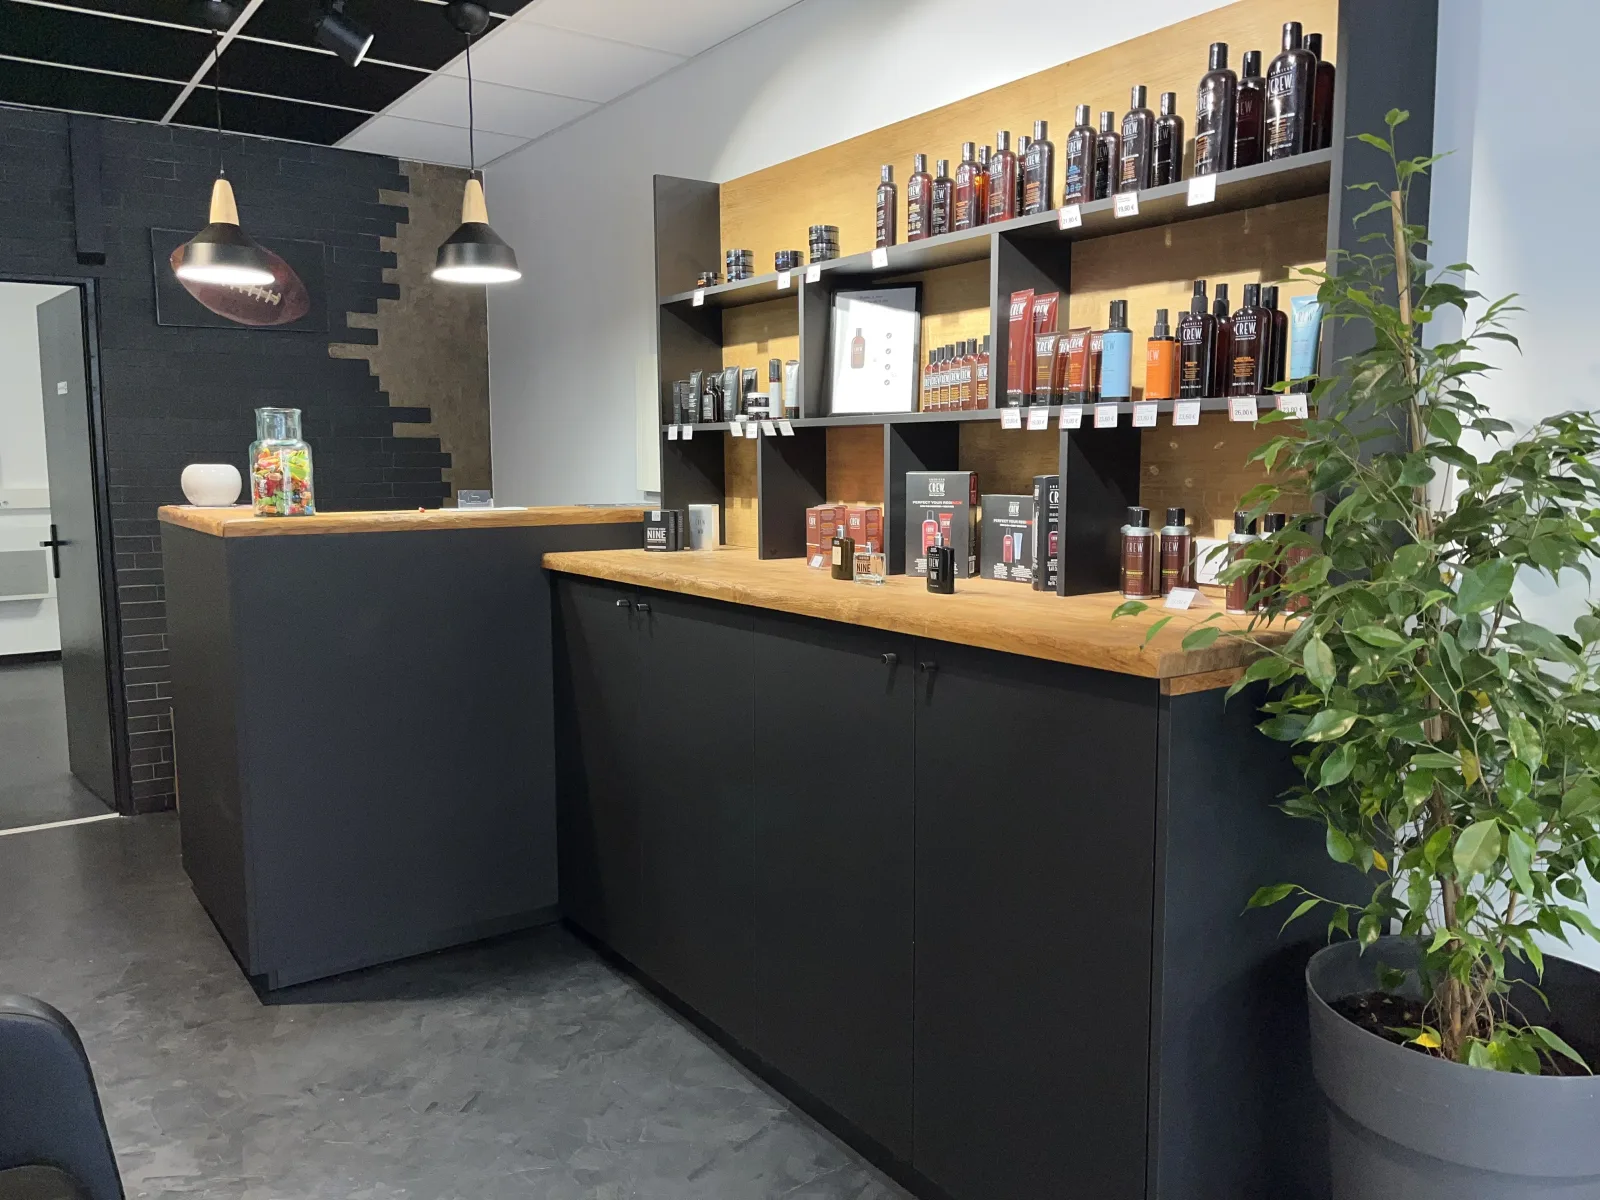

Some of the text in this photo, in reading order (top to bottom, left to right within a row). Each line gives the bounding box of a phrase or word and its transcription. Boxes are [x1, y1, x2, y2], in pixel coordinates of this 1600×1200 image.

[1049, 490, 1059, 504] CR
[646, 530, 667, 539] NINE
[856, 563, 871, 573] NINE
